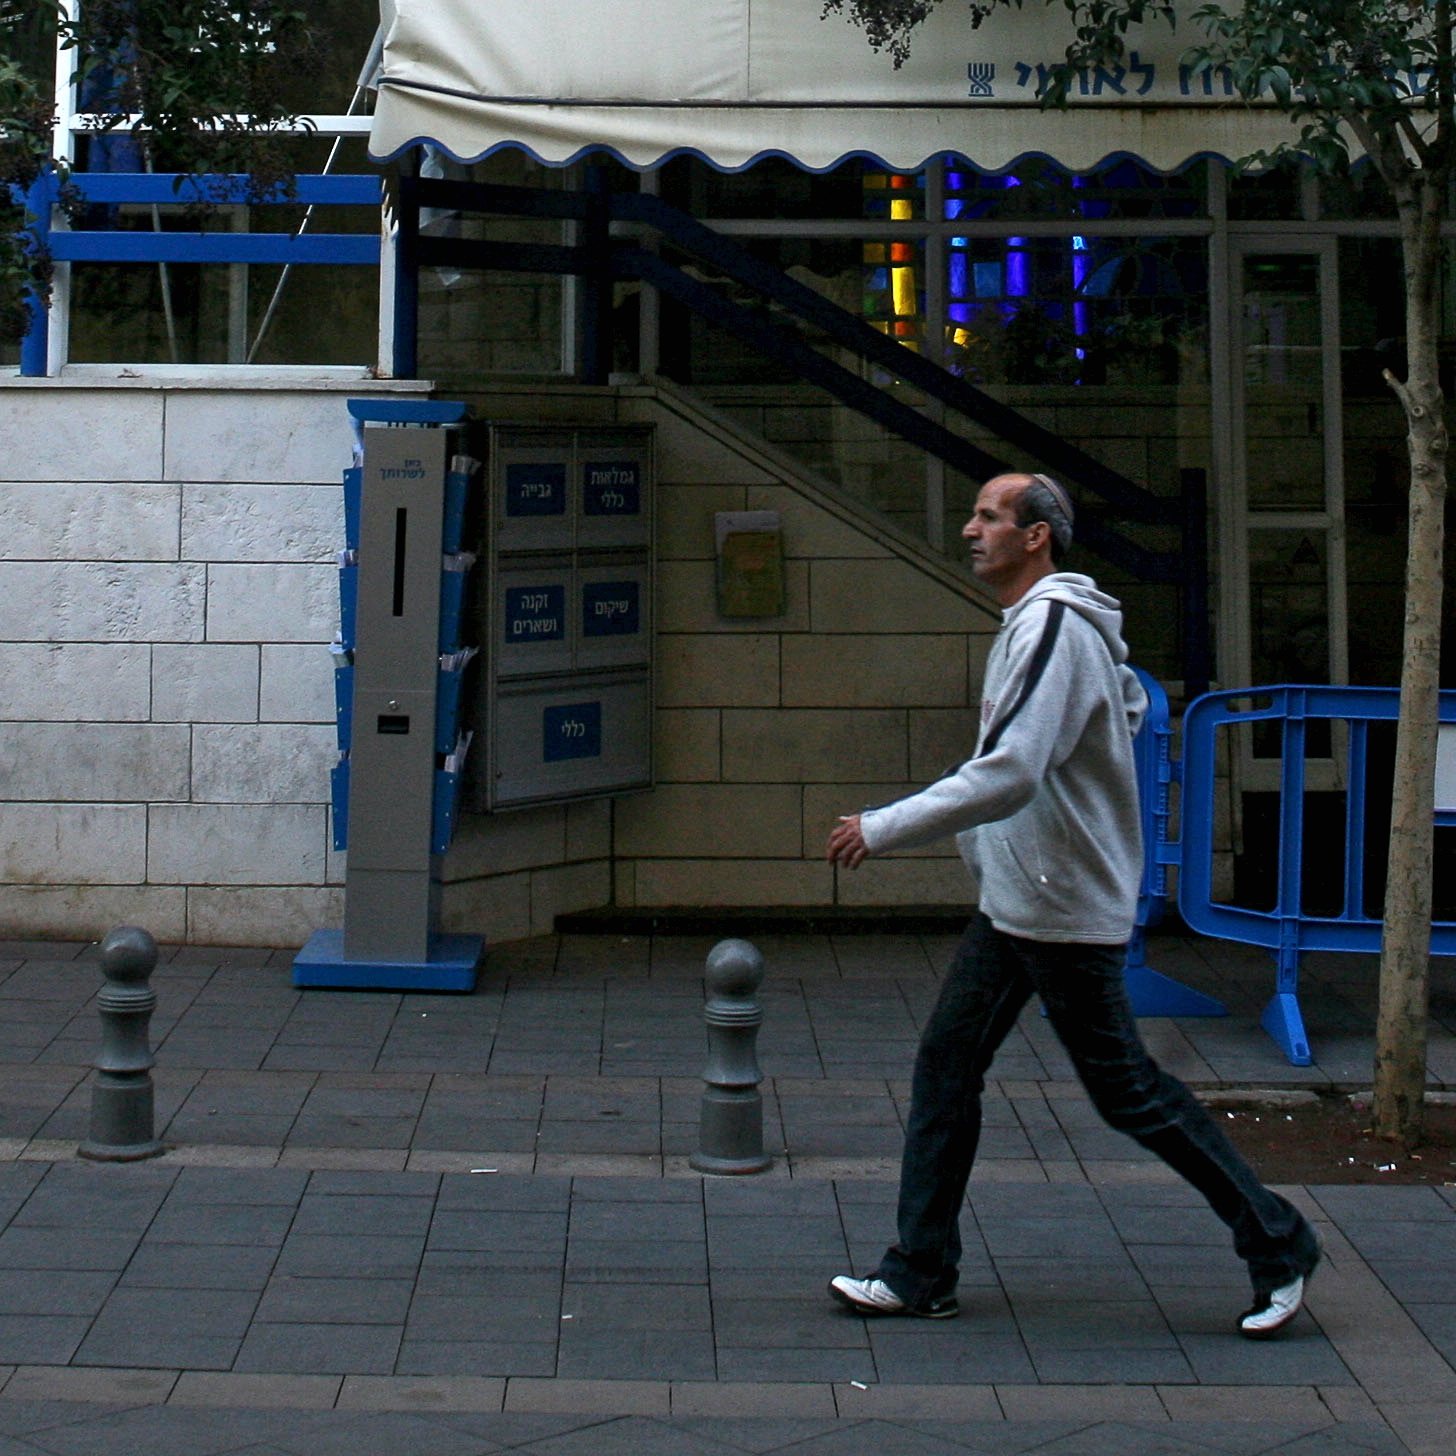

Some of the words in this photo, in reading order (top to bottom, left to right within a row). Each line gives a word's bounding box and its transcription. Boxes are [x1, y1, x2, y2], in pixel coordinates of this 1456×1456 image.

[591, 467, 635, 486] גמלאות
[521, 482, 553, 498] גבייה
[601, 490, 625, 508] כללי
[521, 593, 549, 614] זקנה
[594, 600, 629, 619] שיקום
[513, 619, 558, 635] ושארים
[561, 719, 585, 738] כללי
